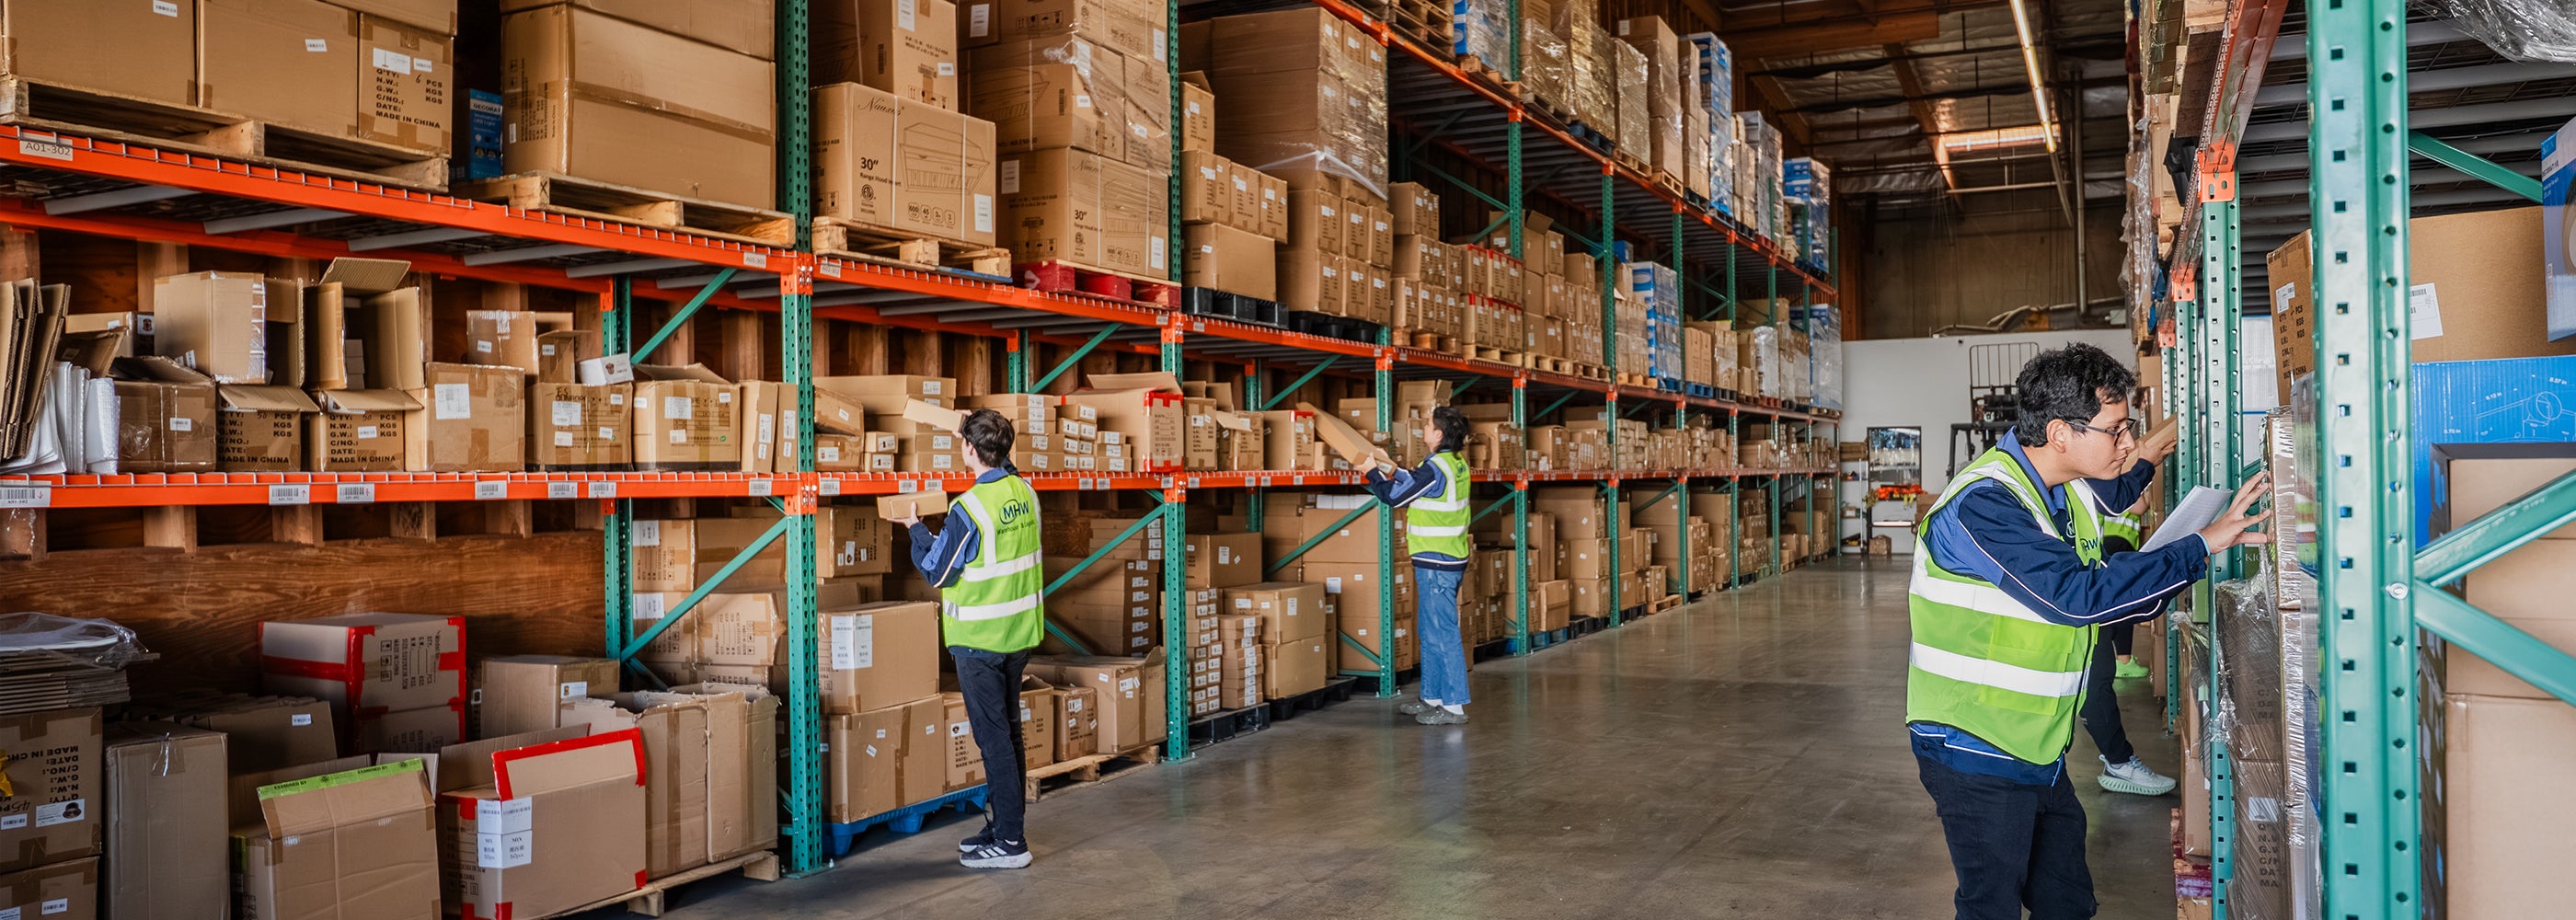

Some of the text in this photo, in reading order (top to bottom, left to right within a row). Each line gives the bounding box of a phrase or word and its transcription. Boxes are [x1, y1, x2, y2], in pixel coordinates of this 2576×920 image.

[426, 79, 443, 88] PCS
[425, 87, 443, 96] KGS
[425, 96, 443, 104] KGS
[376, 102, 401, 112] DATE:
[375, 110, 401, 121] MADE
[414, 118, 441, 128] CHINA
[25, 142, 71, 156] A01-302
[2296, 365, 2306, 375] CHINA
[1003, 501, 1029, 520] MHW
[46, 746, 78, 756] MADE
[46, 755, 78, 765] DATE:
